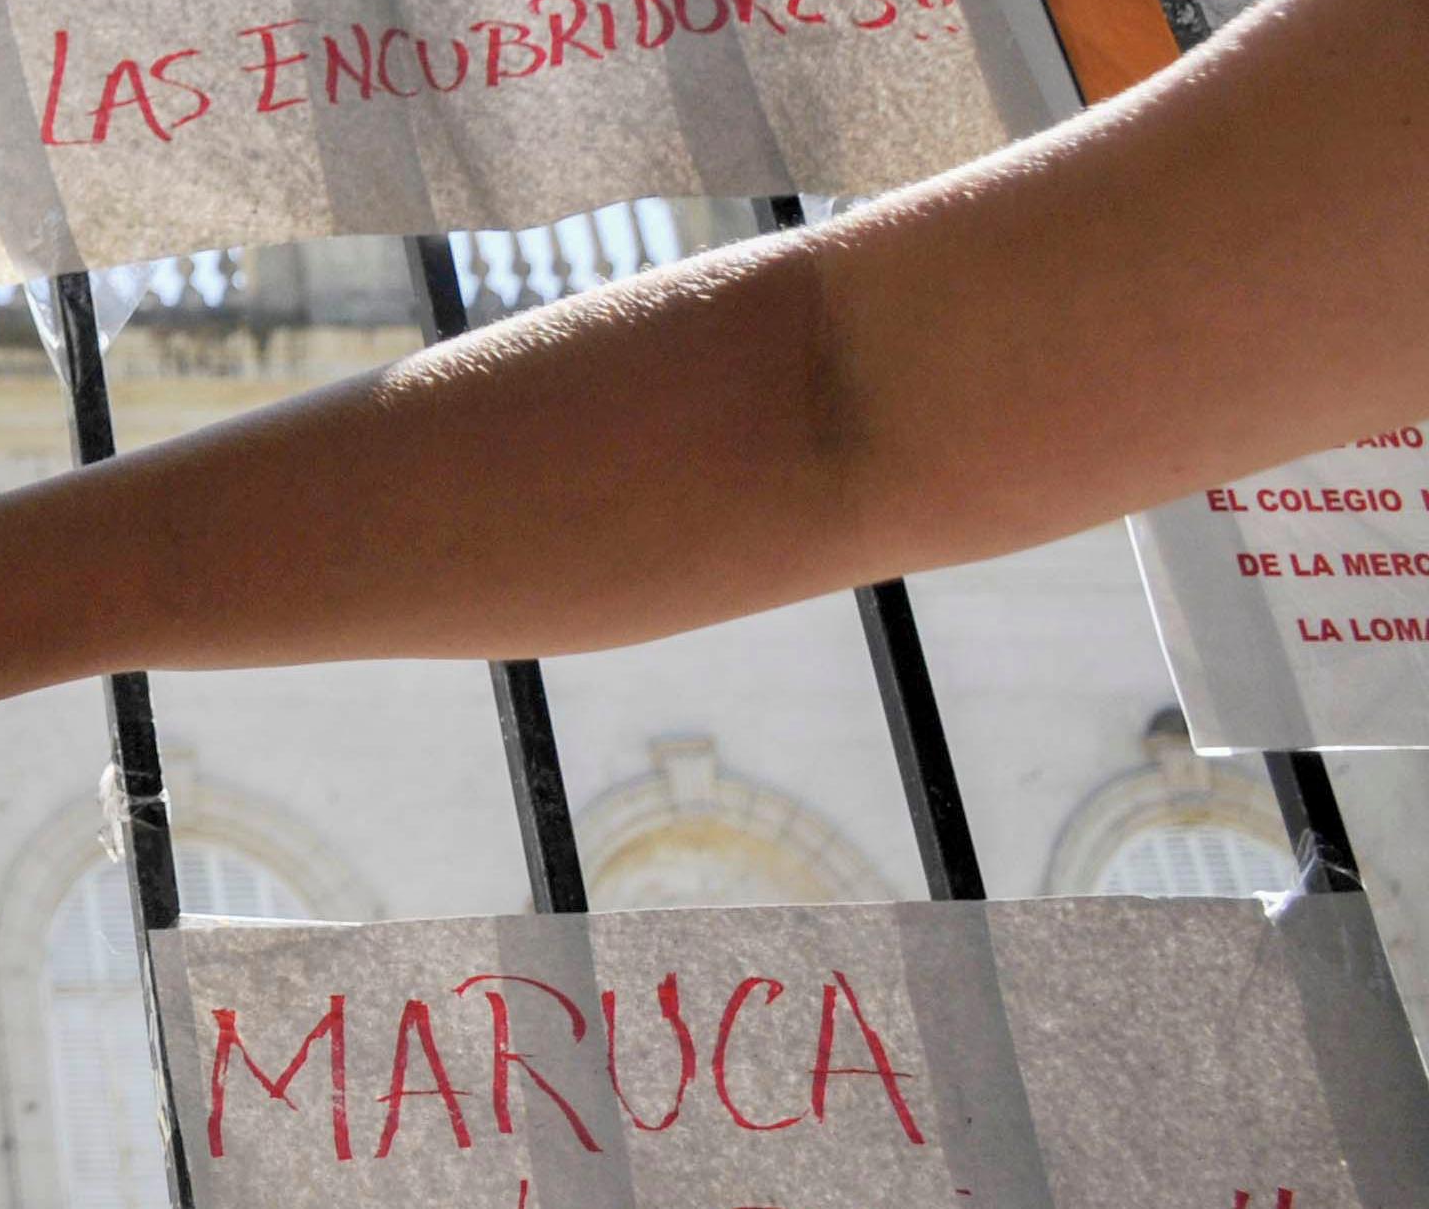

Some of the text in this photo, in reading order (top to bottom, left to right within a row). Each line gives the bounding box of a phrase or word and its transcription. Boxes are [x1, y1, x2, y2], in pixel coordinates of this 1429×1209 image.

[39, 29, 211, 146] LAS
[1206, 489, 1248, 511] EL
[1256, 489, 1403, 512] COLEGIO
[1237, 553, 1281, 576] DE
[1289, 553, 1334, 576] LA
[1298, 618, 1429, 642] LA LOM
[206, 971, 928, 1159] MARUCA
